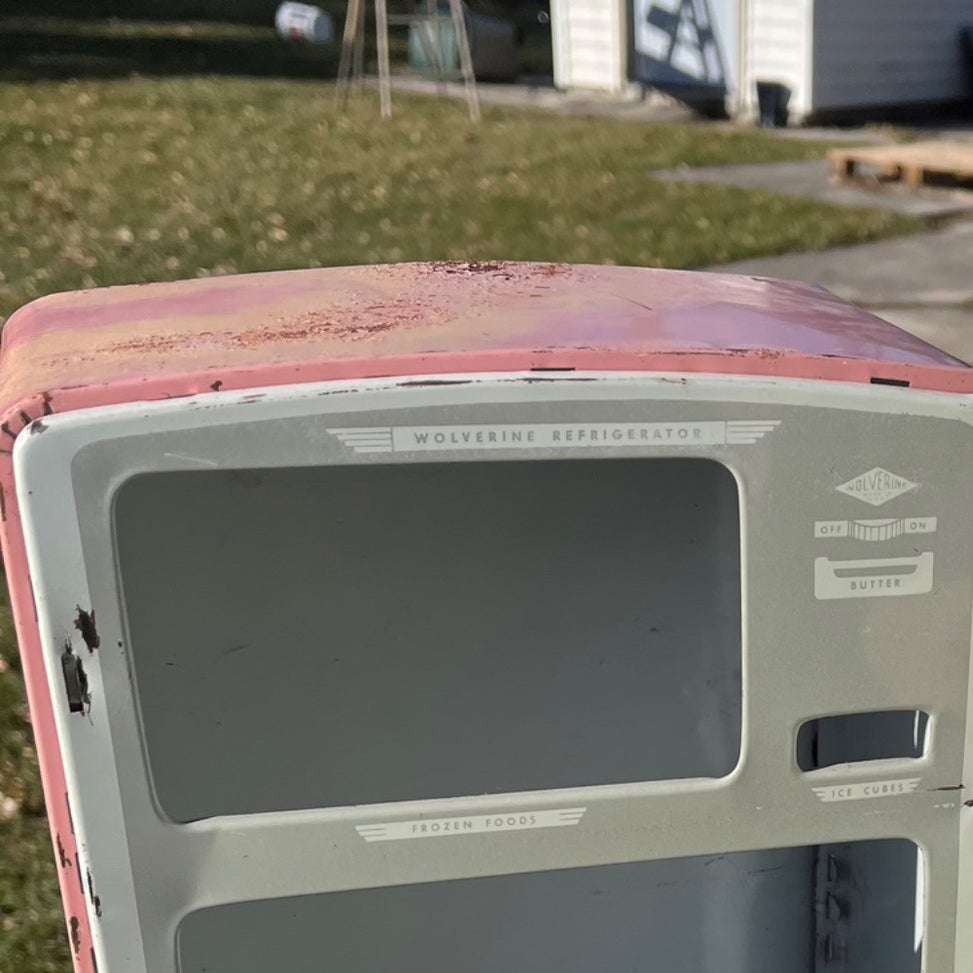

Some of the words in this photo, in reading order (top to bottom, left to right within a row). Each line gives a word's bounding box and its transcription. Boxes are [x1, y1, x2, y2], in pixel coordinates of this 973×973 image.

[414, 431, 536, 444] WOLVERINE
[552, 428, 702, 441] REFRIGERATOR
[820, 525, 842, 534] OFF
[909, 521, 926, 530] ON
[850, 579, 901, 590] BUTTER
[832, 788, 853, 798] ICE
[863, 783, 904, 795] CUBES
[412, 820, 472, 833] FROZEN
[485, 815, 536, 828] FOODS
